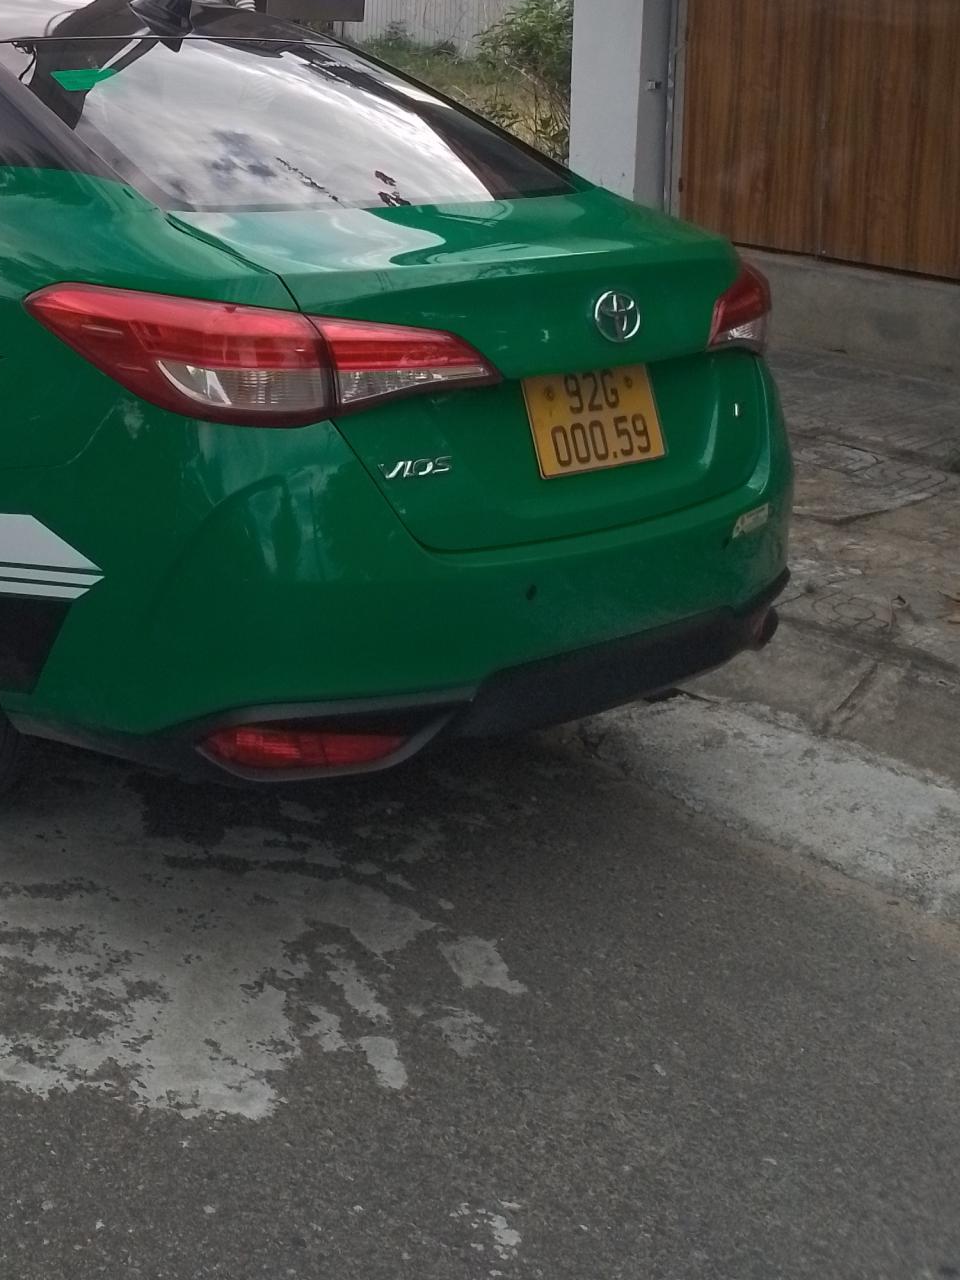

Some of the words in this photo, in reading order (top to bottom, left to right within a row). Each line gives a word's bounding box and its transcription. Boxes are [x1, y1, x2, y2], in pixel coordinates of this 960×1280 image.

[564, 369, 620, 414] 92G
[550, 413, 651, 467] 000.59
[378, 455, 452, 479] VIOS
